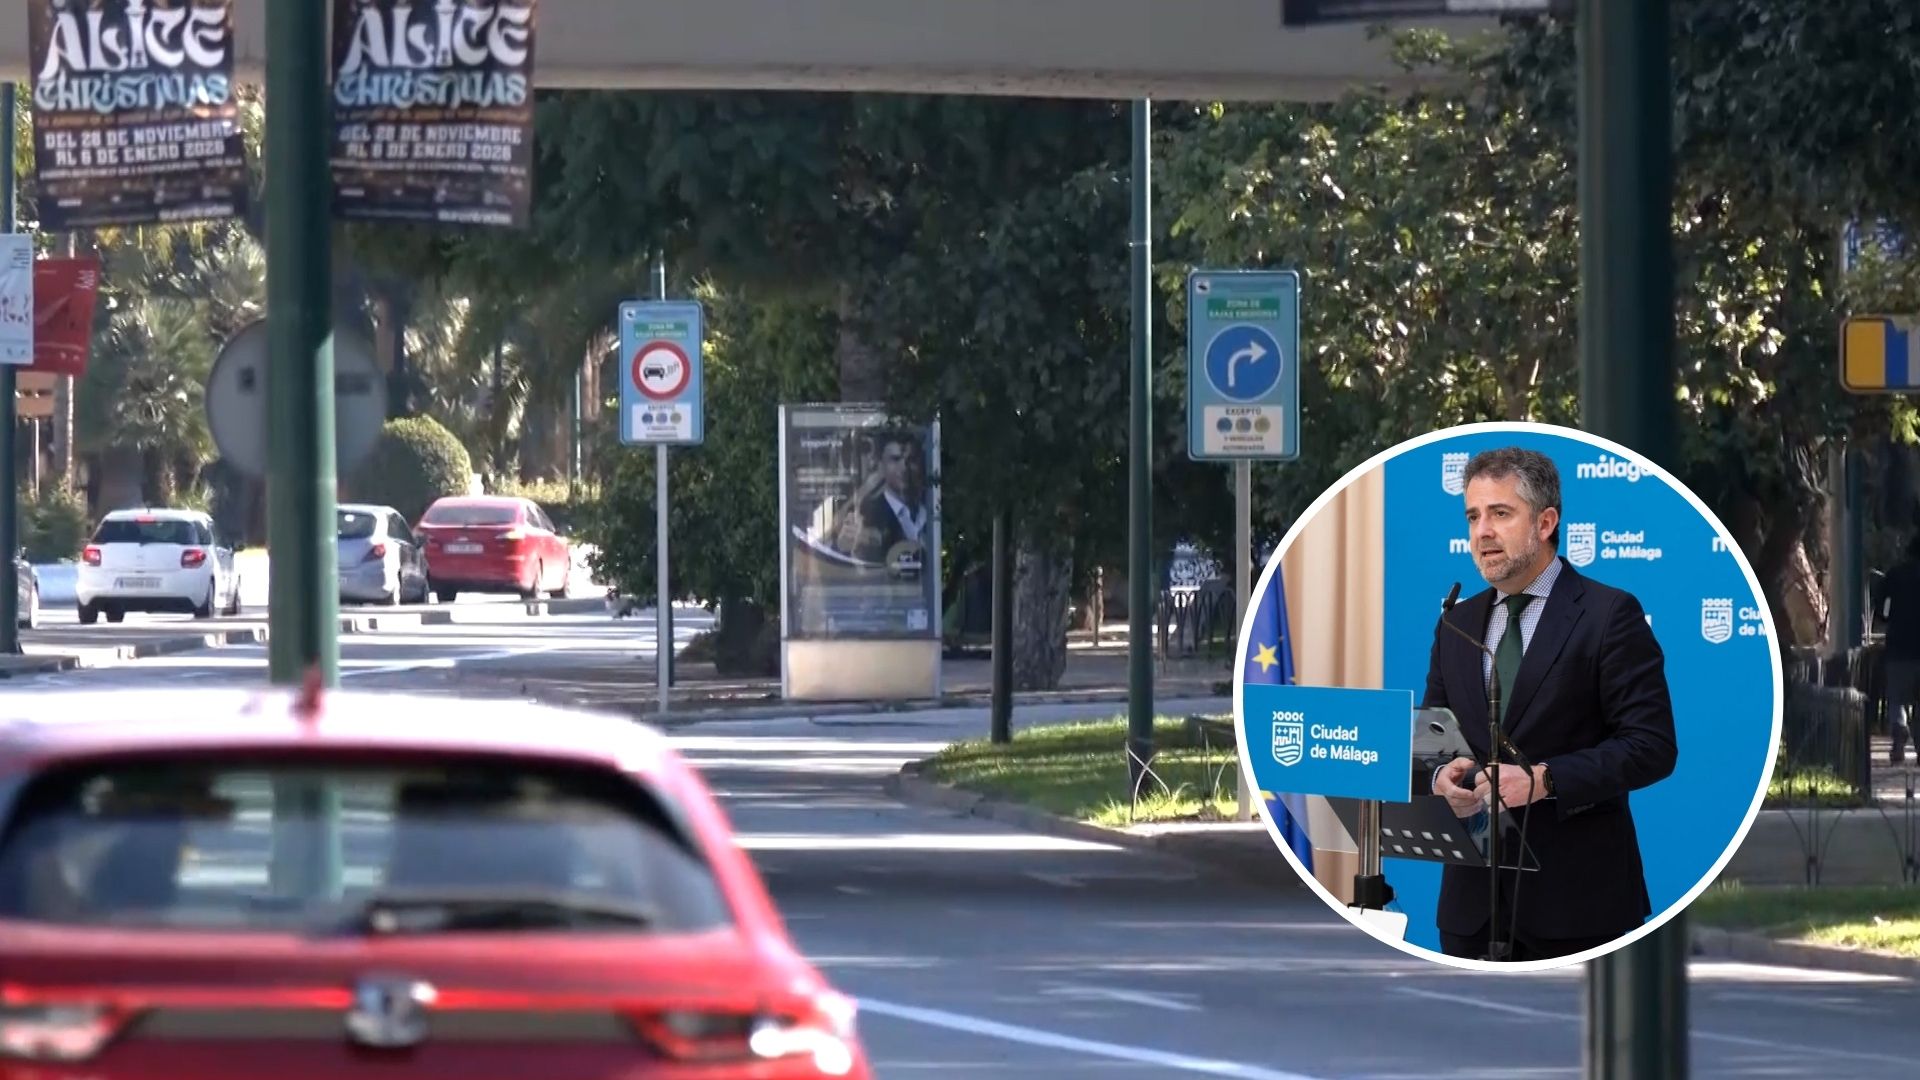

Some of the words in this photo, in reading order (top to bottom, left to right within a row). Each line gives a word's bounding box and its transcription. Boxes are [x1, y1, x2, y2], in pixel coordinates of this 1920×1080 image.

[38, 0, 226, 80] ALICE
[338, 0, 531, 75] ALICE
[45, 132, 76, 150] DEL
[106, 128, 129, 147] DE
[133, 119, 234, 144] NOVIEMBRE
[339, 125, 370, 142] DEL
[400, 125, 422, 141] DE
[426, 124, 522, 144] NOVIEMBRE
[55, 149, 76, 166] AL
[97, 148, 118, 164] DE
[123, 145, 179, 163] ENERO
[346, 143, 368, 159] AL
[387, 144, 408, 160] DE
[413, 143, 467, 160] ENERO
[1225, 407, 1262, 416] EXCEPTO
[1601, 530, 1644, 543] Ciudad
[1601, 546, 1617, 558] de
[1619, 545, 1662, 561] Málaga
[1739, 607, 1764, 620] Ciu
[1739, 623, 1755, 636] de
[1310, 724, 1358, 741] Ciudad
[1310, 744, 1326, 758] de
[1330, 745, 1378, 765] Málaga
